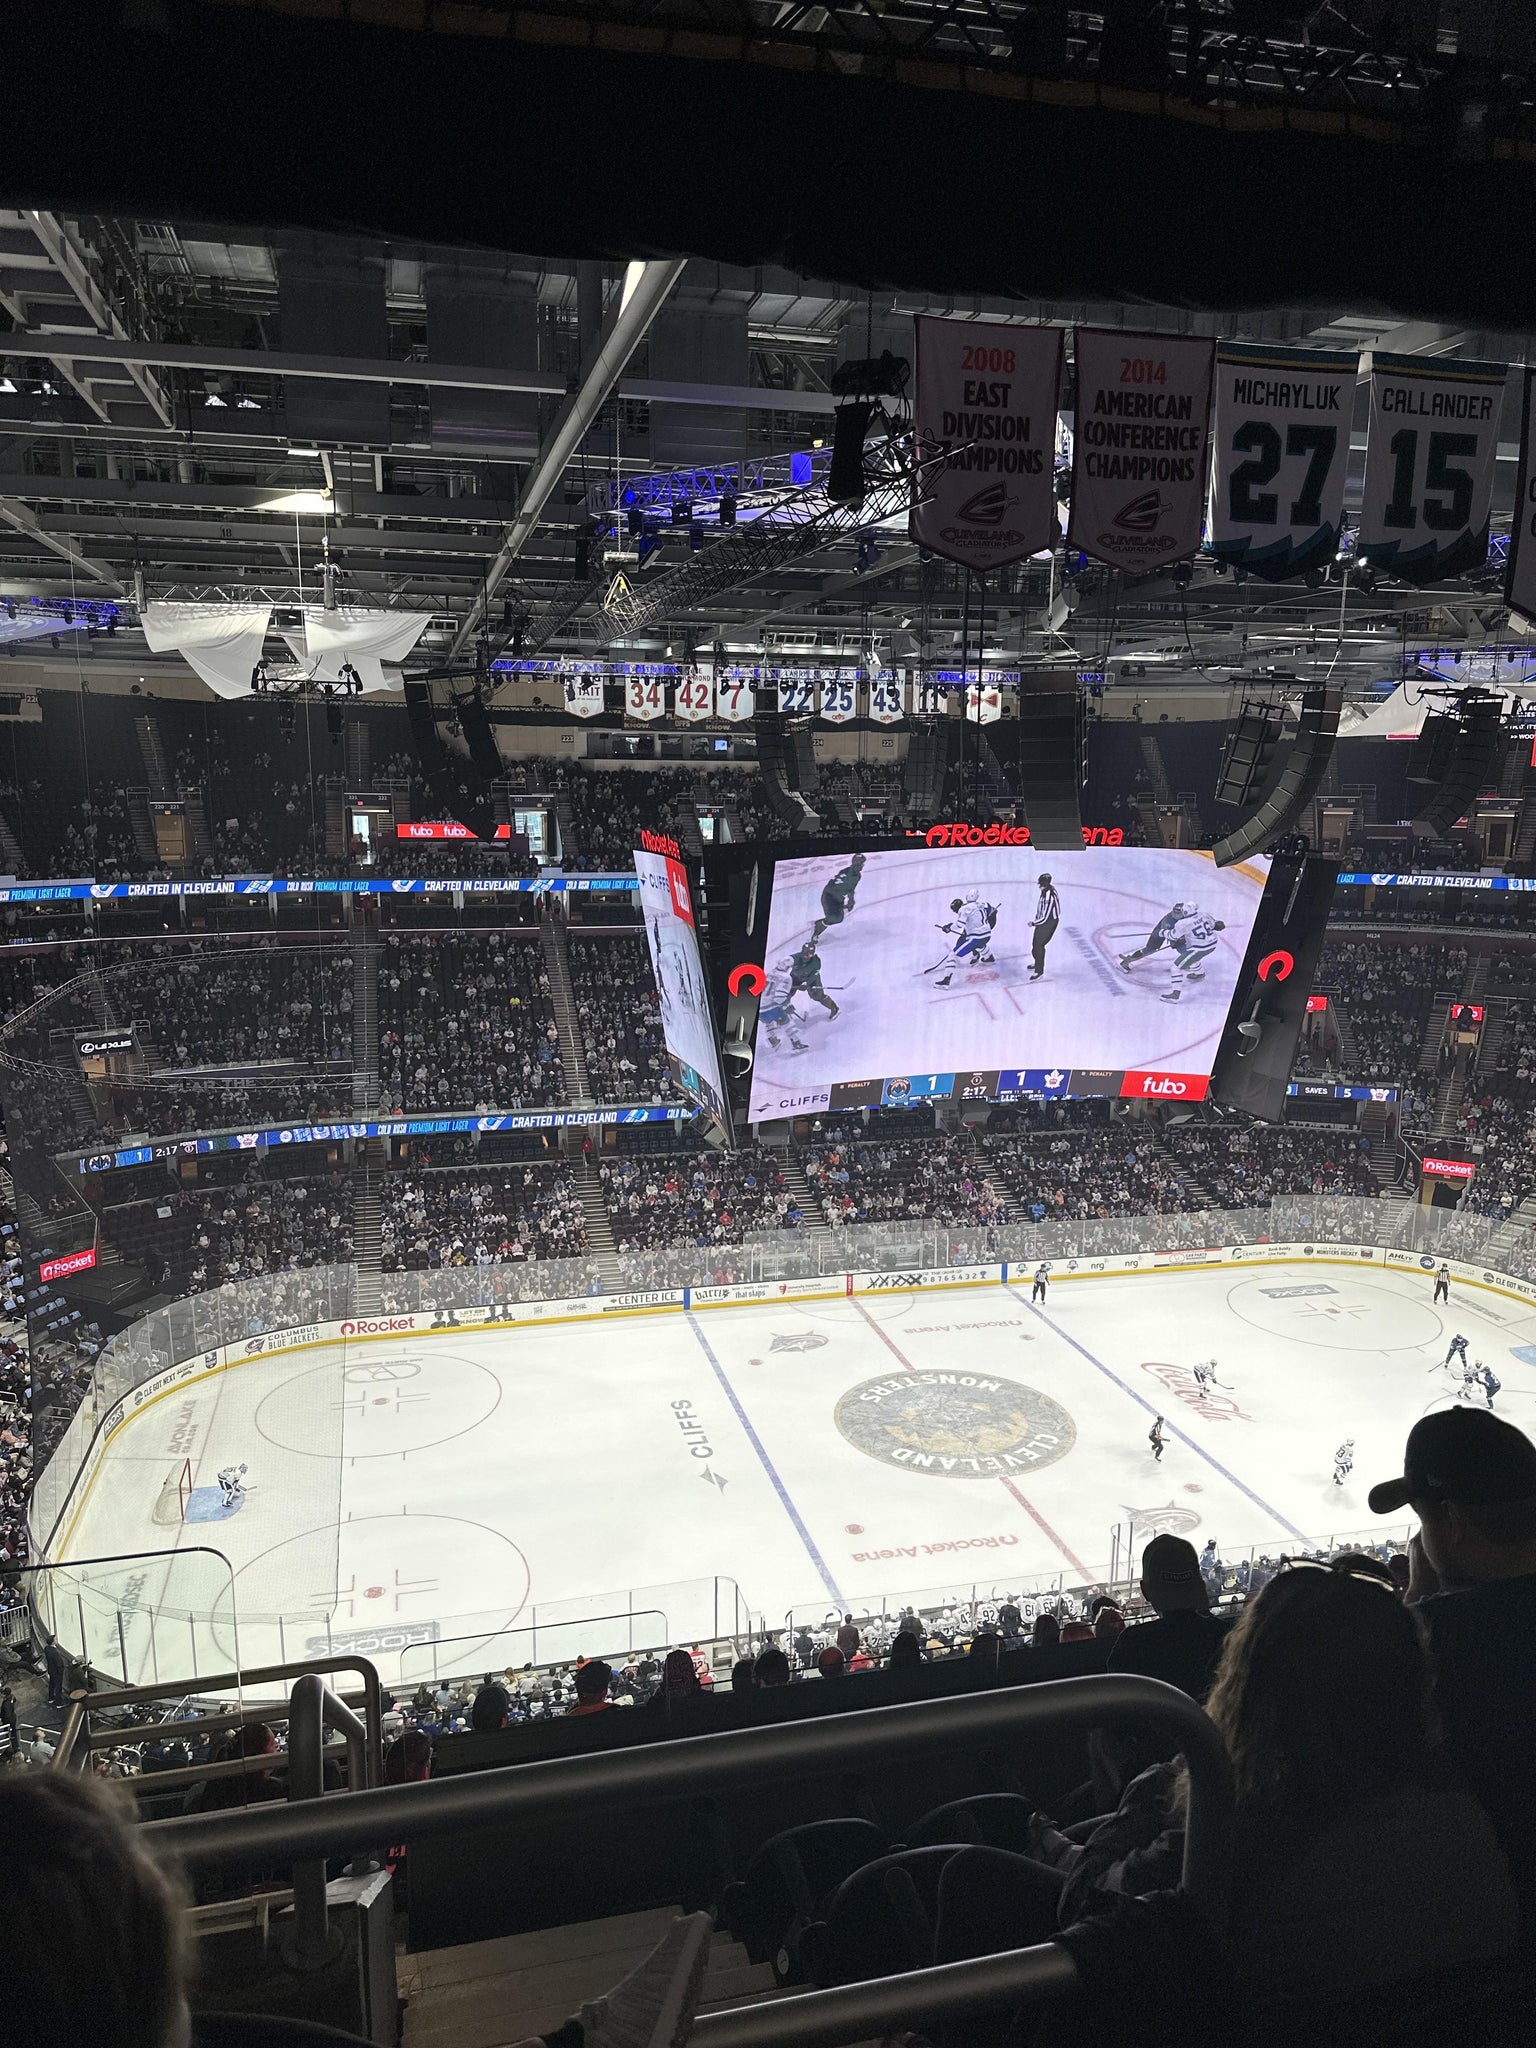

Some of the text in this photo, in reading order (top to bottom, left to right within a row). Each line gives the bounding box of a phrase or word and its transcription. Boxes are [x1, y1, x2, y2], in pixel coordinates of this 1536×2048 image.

[961, 345, 1016, 374] 2008
[1119, 357, 1168, 385] 2014
[963, 379, 1012, 409] EAST
[1233, 378, 1342, 411] MICHAYLUK
[1093, 389, 1193, 421] AMERICAN
[1381, 387, 1493, 421] CALLANDER
[942, 410, 1031, 443] DIVISION
[1083, 419, 1201, 452] CONFERENCE
[1084, 451, 1196, 483] CHAMPIONS
[1229, 420, 1338, 527] 27
[1383, 428, 1479, 532] 15
[939, 526, 1026, 546] CLEVELAND
[1096, 532, 1178, 550] CLEVELAND
[577, 686, 601, 697] TAIT
[630, 682, 660, 709] 34
[679, 683, 709, 710] 42
[728, 684, 743, 710] 7
[781, 685, 810, 711] 22
[824, 684, 853, 712] 25
[872, 687, 900, 713] 43
[919, 683, 941, 713] 11
[561, 735, 574, 743] 223
[409, 825, 467, 838] fubo fubo
[949, 822, 1124, 846] Rocke ena
[127, 881, 235, 896] CRAFTED IN CLEVELAND
[286, 881, 300, 891] COLD
[314, 881, 338, 891] PREMIUM
[338, 881, 353, 891] LIGHT
[353, 881, 370, 891] LAGER
[424, 880, 520, 891] CRAFTED IN CLEVELAND
[590, 880, 611, 889] PREMIUM
[611, 880, 625, 889] LIGHT
[649, 873, 671, 893] CLIFFS
[1396, 875, 1493, 889] CRAFTED IN CLEVELAND
[11, 887, 71, 900] PREMIUM LIGHT LAGER
[94, 1039, 132, 1051] LEXUS
[847, 1081, 871, 1089] PENALTY
[927, 1075, 938, 1091] 1
[1016, 1070, 1027, 1086] 1
[1143, 1076, 1187, 1095] fubo
[962, 1085, 988, 1097] 2:17
[1304, 1087, 1328, 1095] SAVES
[1344, 1088, 1352, 1098] 5
[779, 1093, 829, 1109] CLIFFS
[377, 1119, 469, 1135] COLD RUSH PREMIUM LIGHT LAGER
[511, 1111, 617, 1129] CRAFTED IN CLEVELAND
[155, 1145, 178, 1158] 2:17
[207, 1140, 214, 1150] 1
[1435, 1161, 1473, 1176] Rocket
[53, 1253, 93, 1275] Rocket
[1090, 1262, 1105, 1270] nrg
[1125, 1260, 1139, 1268] nrg
[735, 1290, 748, 1299] that
[1495, 1277, 1530, 1295] CLE GOT NEXT
[618, 1291, 677, 1306] CENTER ICE
[267, 1325, 320, 1342] COLUMBUS
[357, 1316, 415, 1335] Rocket
[267, 1333, 321, 1350] BLUE JACKETS
[143, 1372, 176, 1398] CLE GOT NEXT
[859, 1373, 1003, 1404] MONSTERS
[670, 1399, 714, 1459] CLIFFS
[891, 1432, 1060, 1471] CLEVELAND
[852, 1534, 1000, 1563] Rocket Arena
[982, 1609, 996, 1622] 92
[1025, 1604, 1035, 1617] 61
